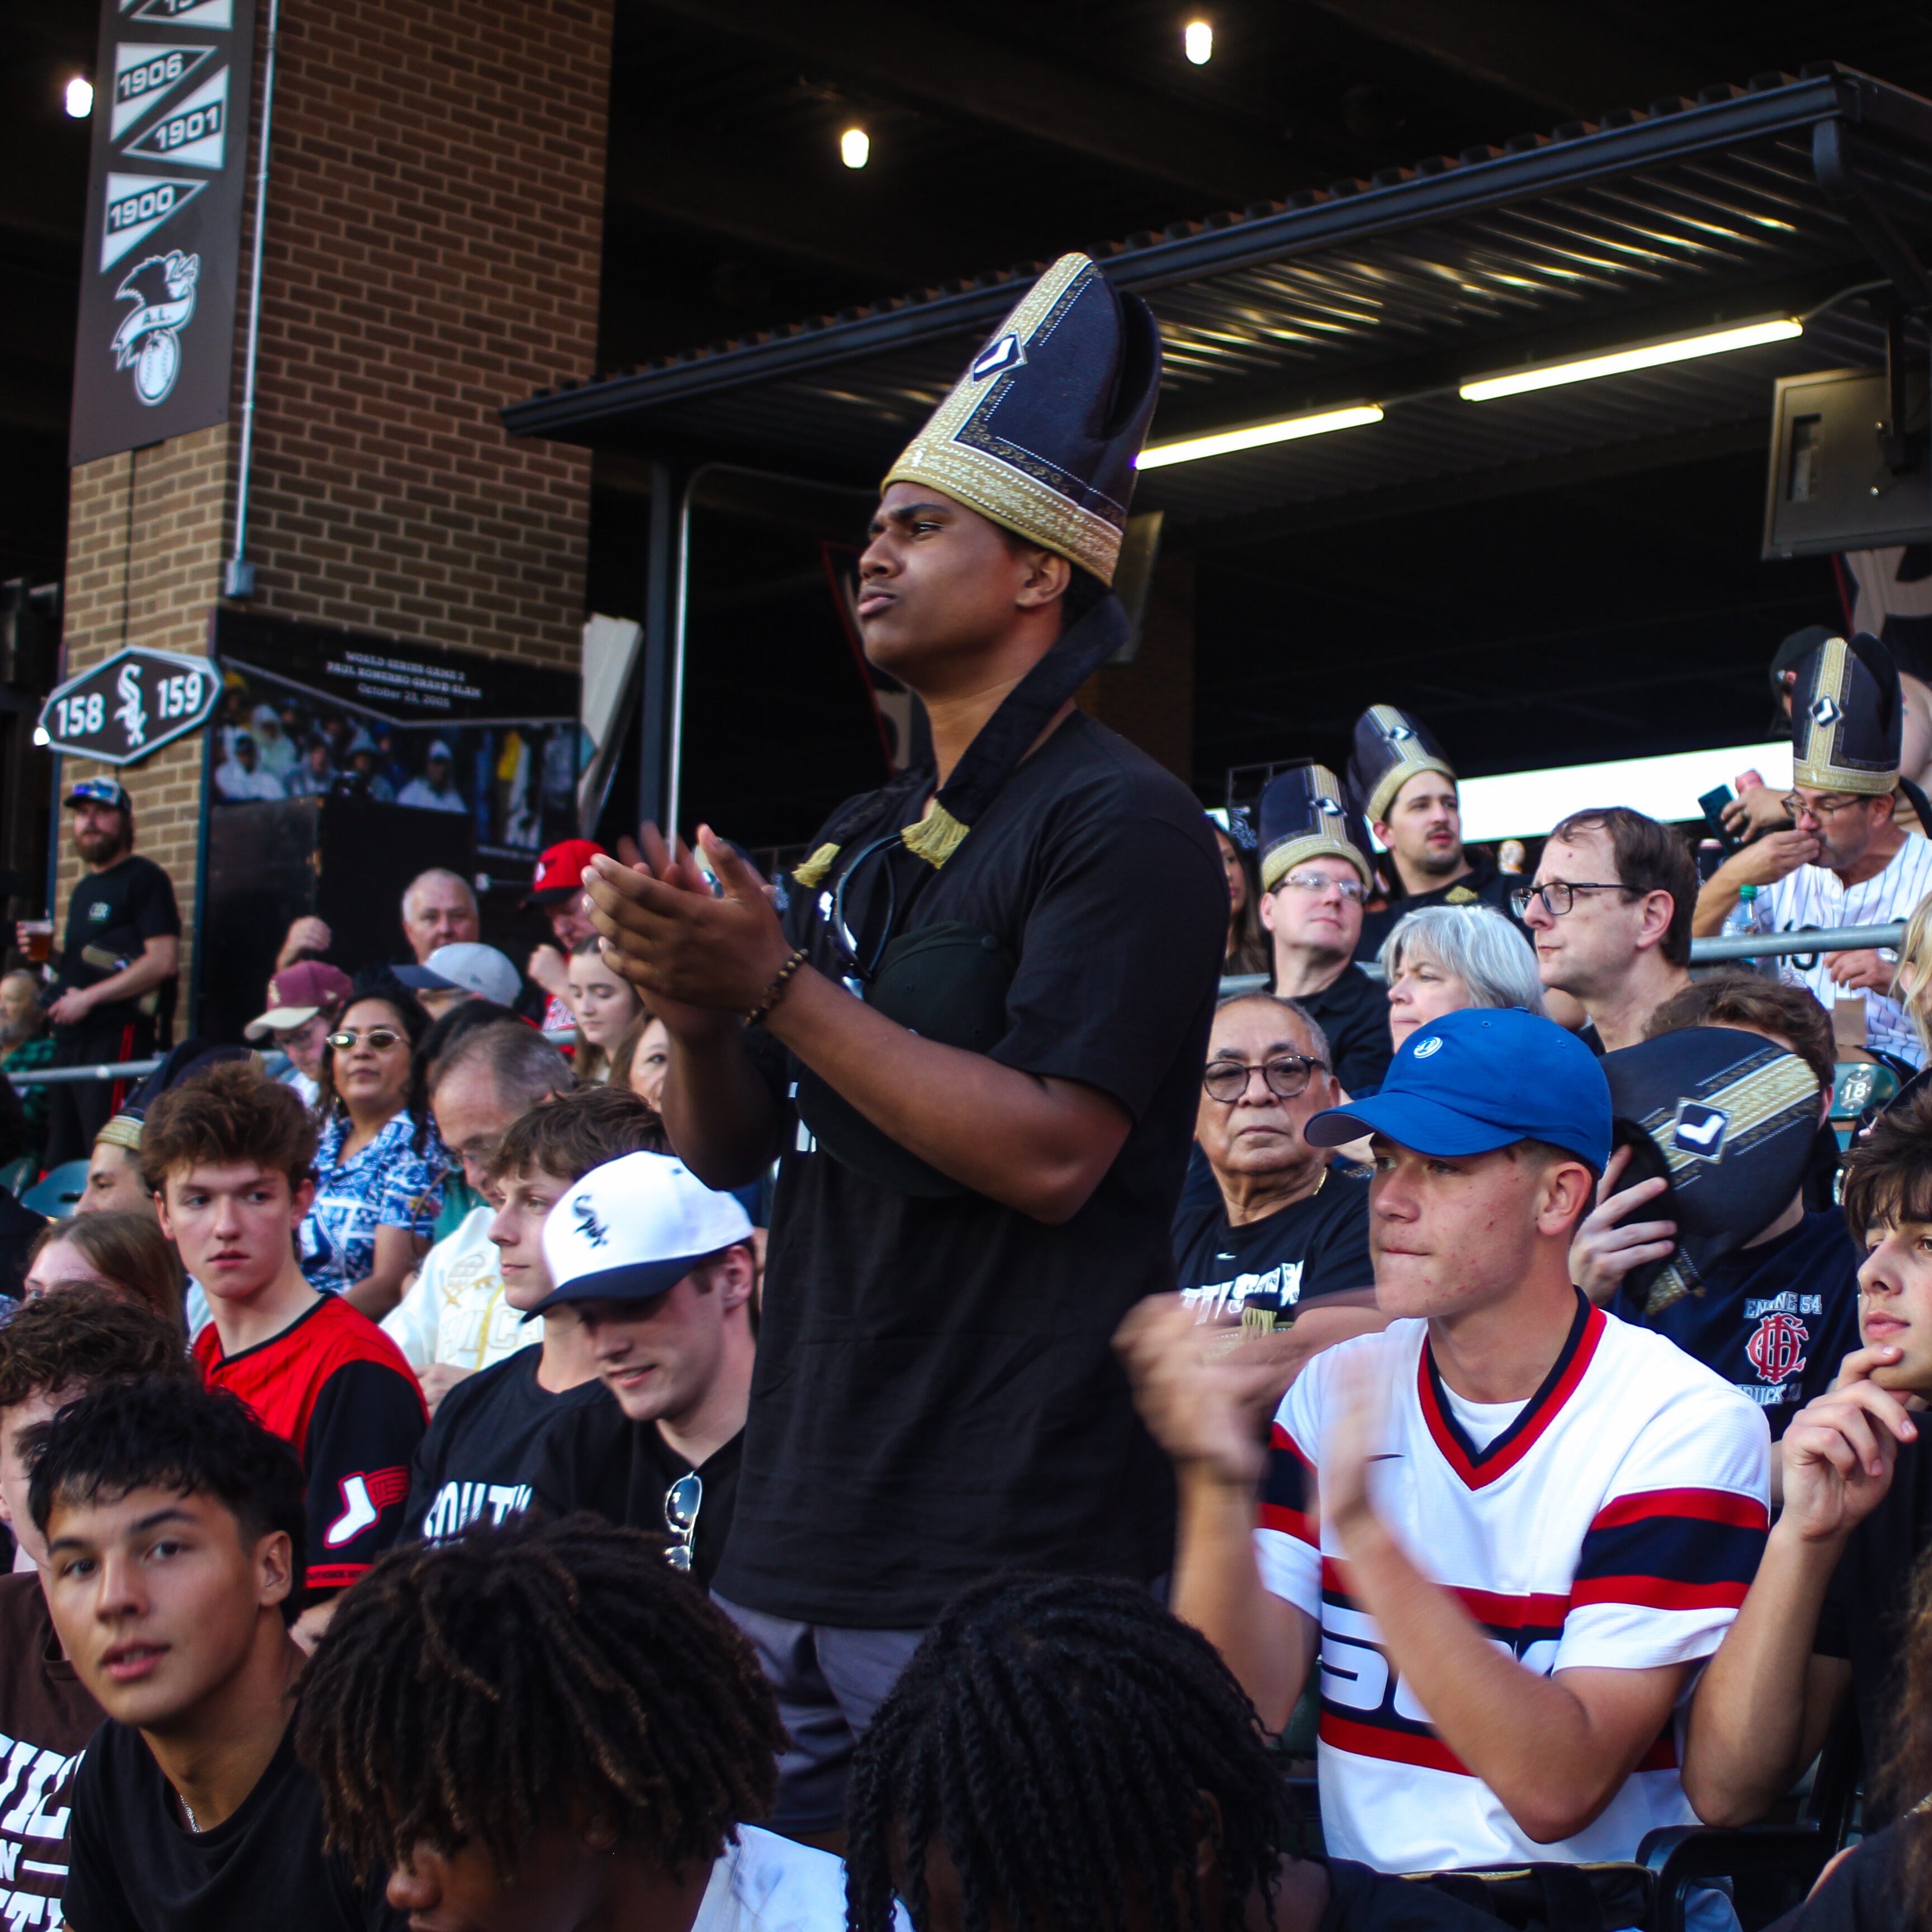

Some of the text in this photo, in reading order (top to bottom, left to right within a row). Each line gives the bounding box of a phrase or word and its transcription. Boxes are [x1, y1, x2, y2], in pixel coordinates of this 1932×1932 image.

[120, 53, 183, 97] 1906
[155, 106, 219, 149] 1901
[111, 186, 174, 227] 1900
[326, 661, 356, 675] PAUL
[411, 677, 449, 693] GRAND
[345, 651, 465, 682] WORLD SERIES GAME 2
[57, 693, 105, 738] 158
[157, 672, 203, 719] 159
[358, 684, 401, 699] October
[1844, 1082, 1867, 1099] 18
[1800, 1294, 1822, 1314] 54
